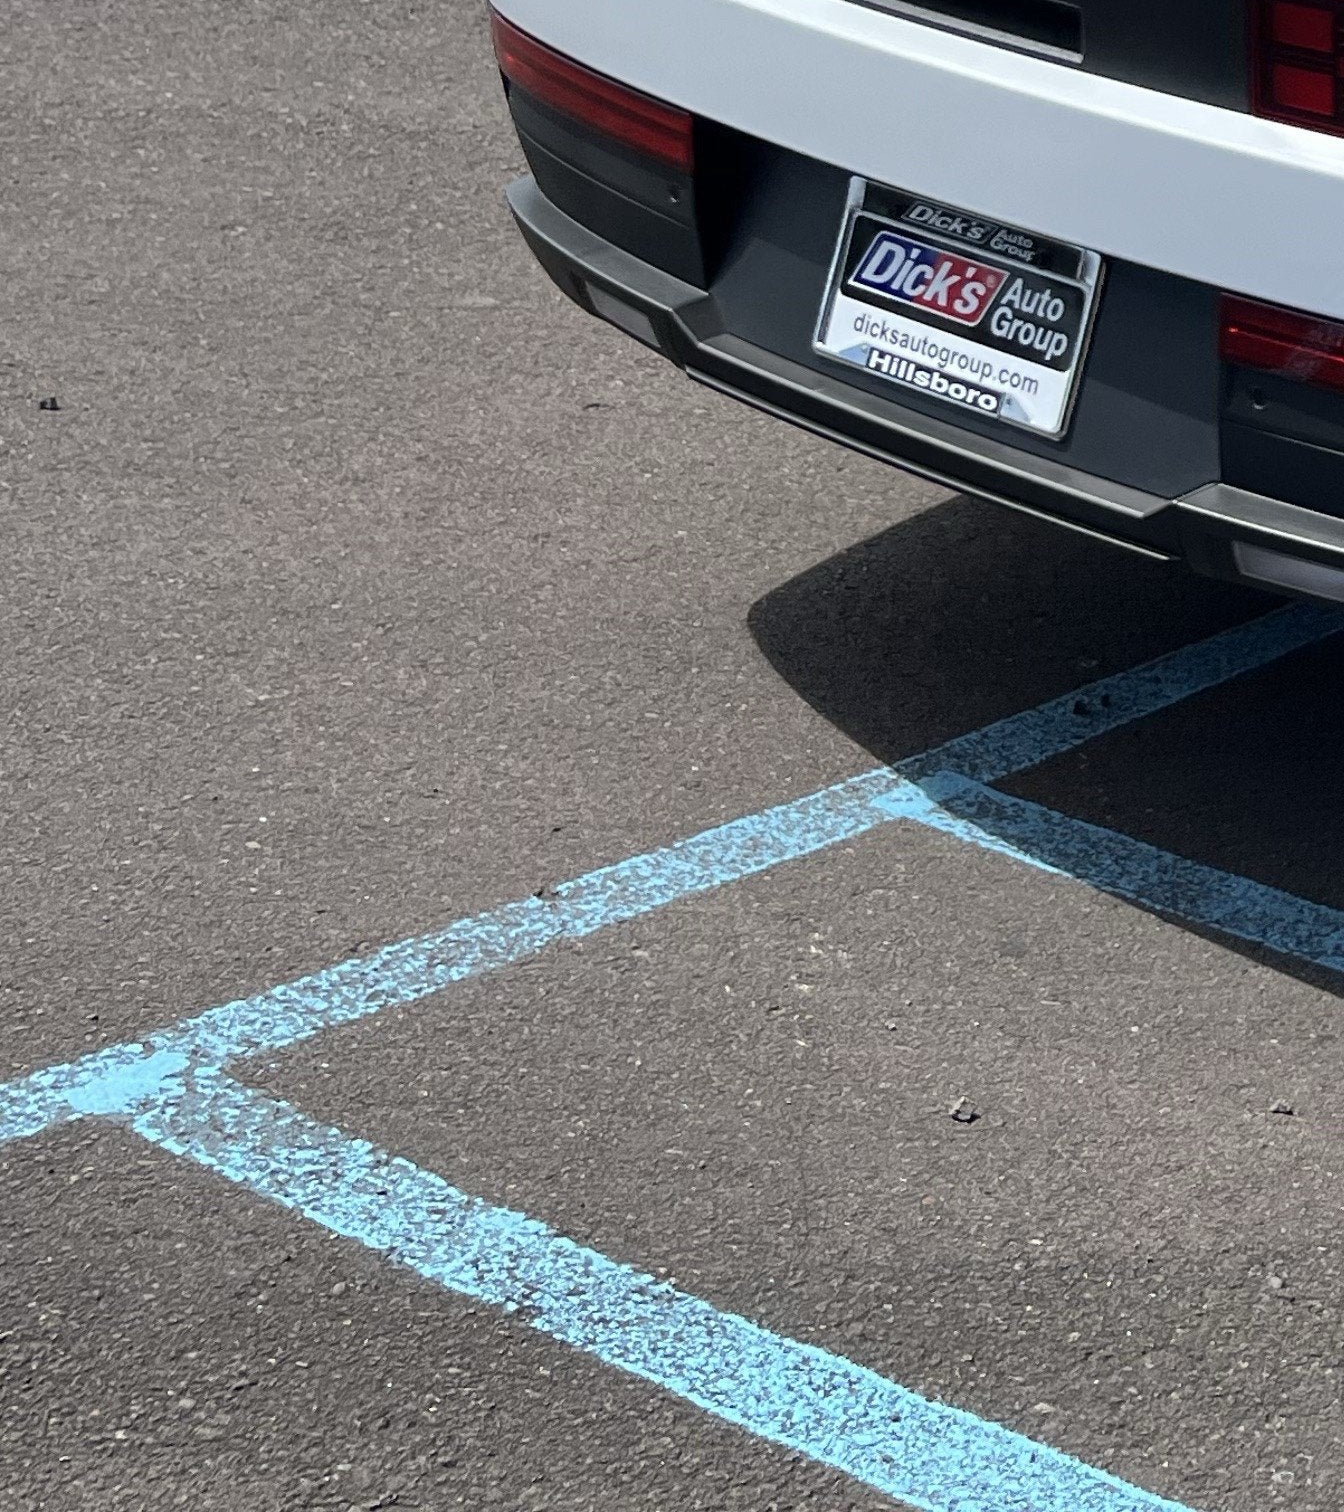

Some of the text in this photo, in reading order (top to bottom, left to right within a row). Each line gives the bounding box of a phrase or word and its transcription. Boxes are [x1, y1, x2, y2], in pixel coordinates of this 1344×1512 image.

[908, 205, 985, 239] Dick's
[999, 229, 1034, 249] Auto
[860, 240, 987, 315] Dick's
[1000, 277, 1065, 322] Auto
[853, 313, 1039, 396] dicksautogroup.com
[990, 307, 1069, 361] Group
[868, 349, 998, 411] Hillsboro
